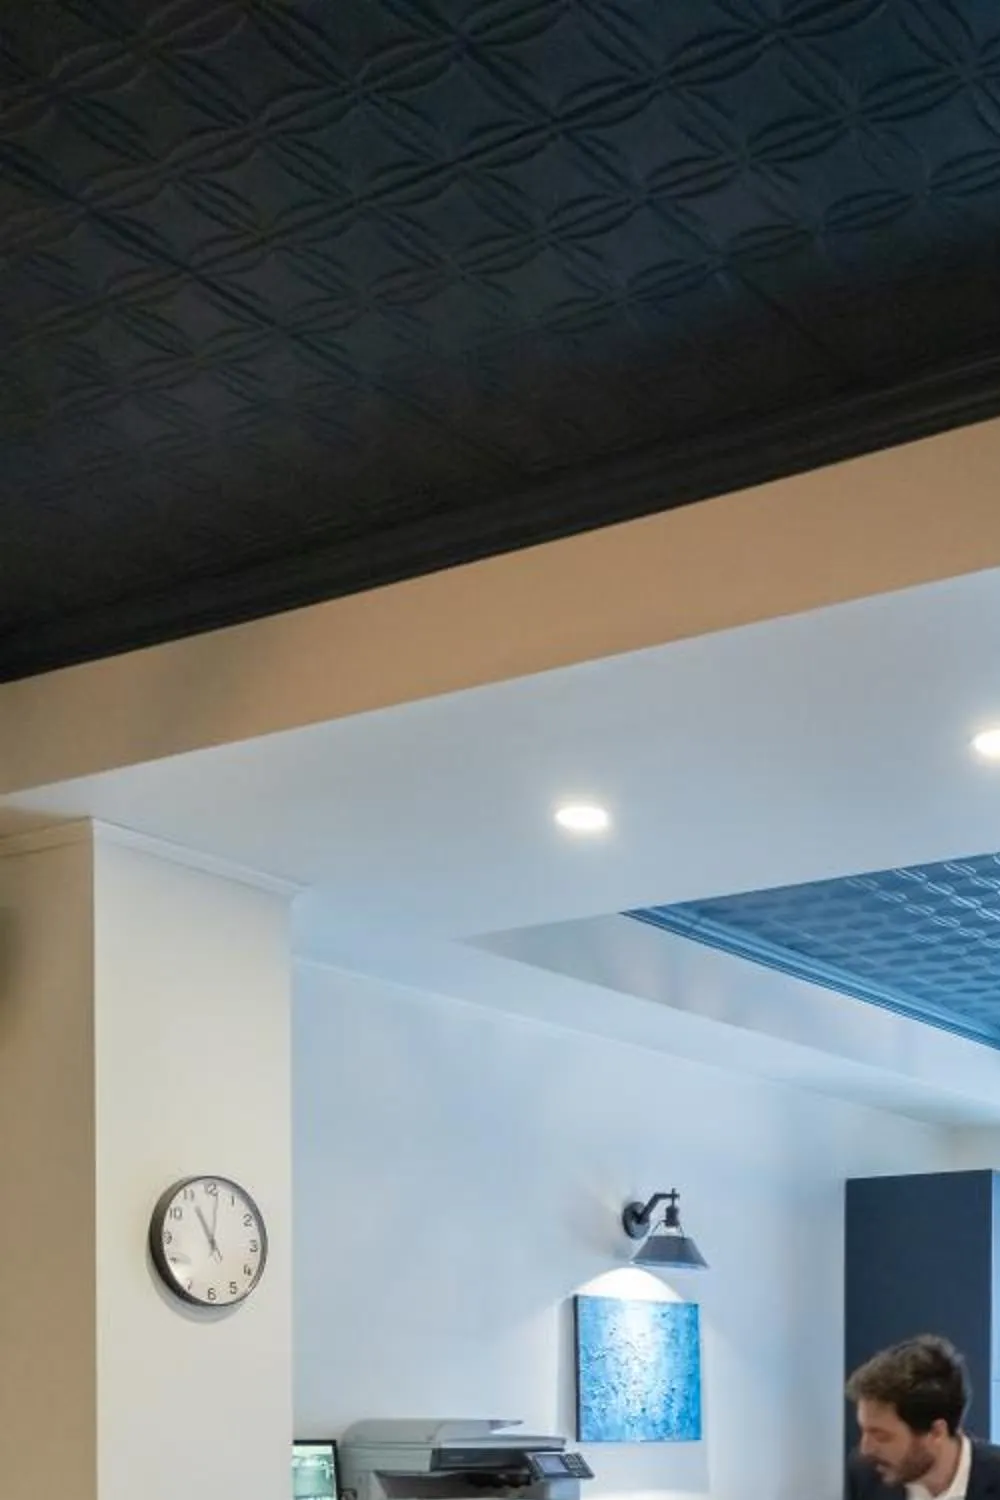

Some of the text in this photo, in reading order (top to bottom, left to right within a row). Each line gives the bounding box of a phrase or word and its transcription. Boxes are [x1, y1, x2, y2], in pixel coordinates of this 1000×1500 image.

[169, 1207, 182, 1221] 10
[243, 1214, 253, 1227] 2
[249, 1240, 259, 1253] 3
[243, 1264, 252, 1276] 4
[207, 1287, 217, 1301] 6
[229, 1281, 238, 1295] 5
